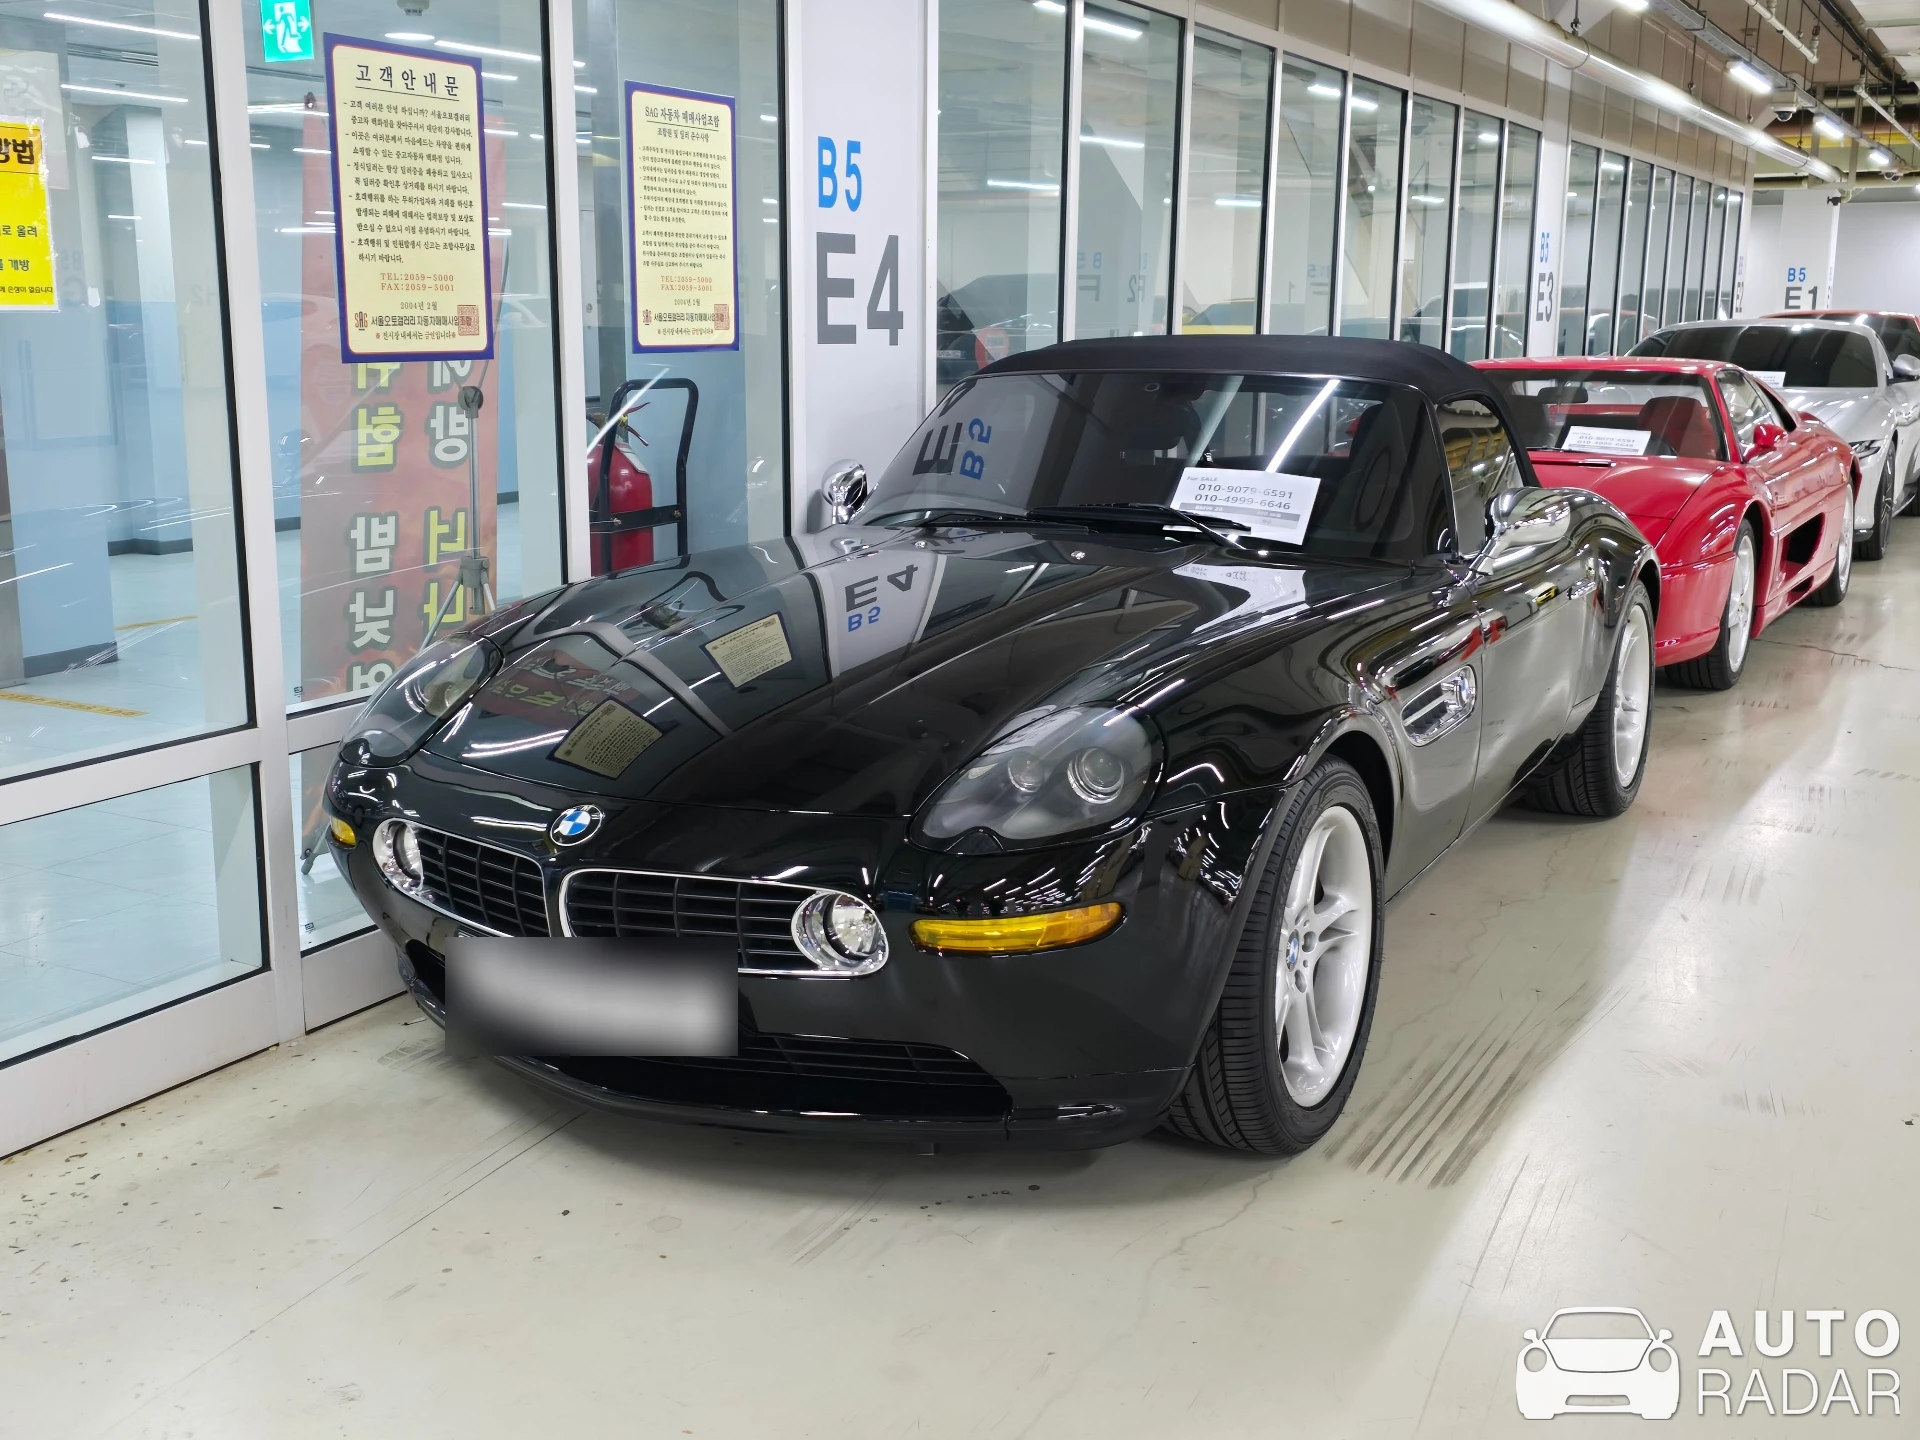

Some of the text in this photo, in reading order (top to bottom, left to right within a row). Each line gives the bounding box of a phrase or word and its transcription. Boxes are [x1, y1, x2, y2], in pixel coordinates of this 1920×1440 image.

[644, 106, 720, 128] SAG 자동차 매매사업조합
[657, 127, 672, 138] 조합원
[817, 136, 862, 212] B5
[0, 225, 38, 238] 로 올려
[1540, 232, 1550, 264] B5
[8, 258, 30, 271] 개방
[380, 273, 454, 282] TEL:2059-5000
[660, 275, 713, 283] TEL:2059-5000
[1787, 267, 1806, 283] B5
[381, 283, 455, 291] FAX:2059-5001
[816, 231, 904, 346] E4
[1536, 271, 1554, 322] E3
[1785, 286, 1818, 310] E1
[400, 302, 438, 311] 2004년 2월
[371, 315, 416, 327] 서울오토갤러리
[383, 331, 399, 341] 전시장
[401, 331, 423, 340] 내에서는
[1198, 483, 1294, 499] 010-9079-6591
[1194, 493, 1291, 510] 010-4999-6646
